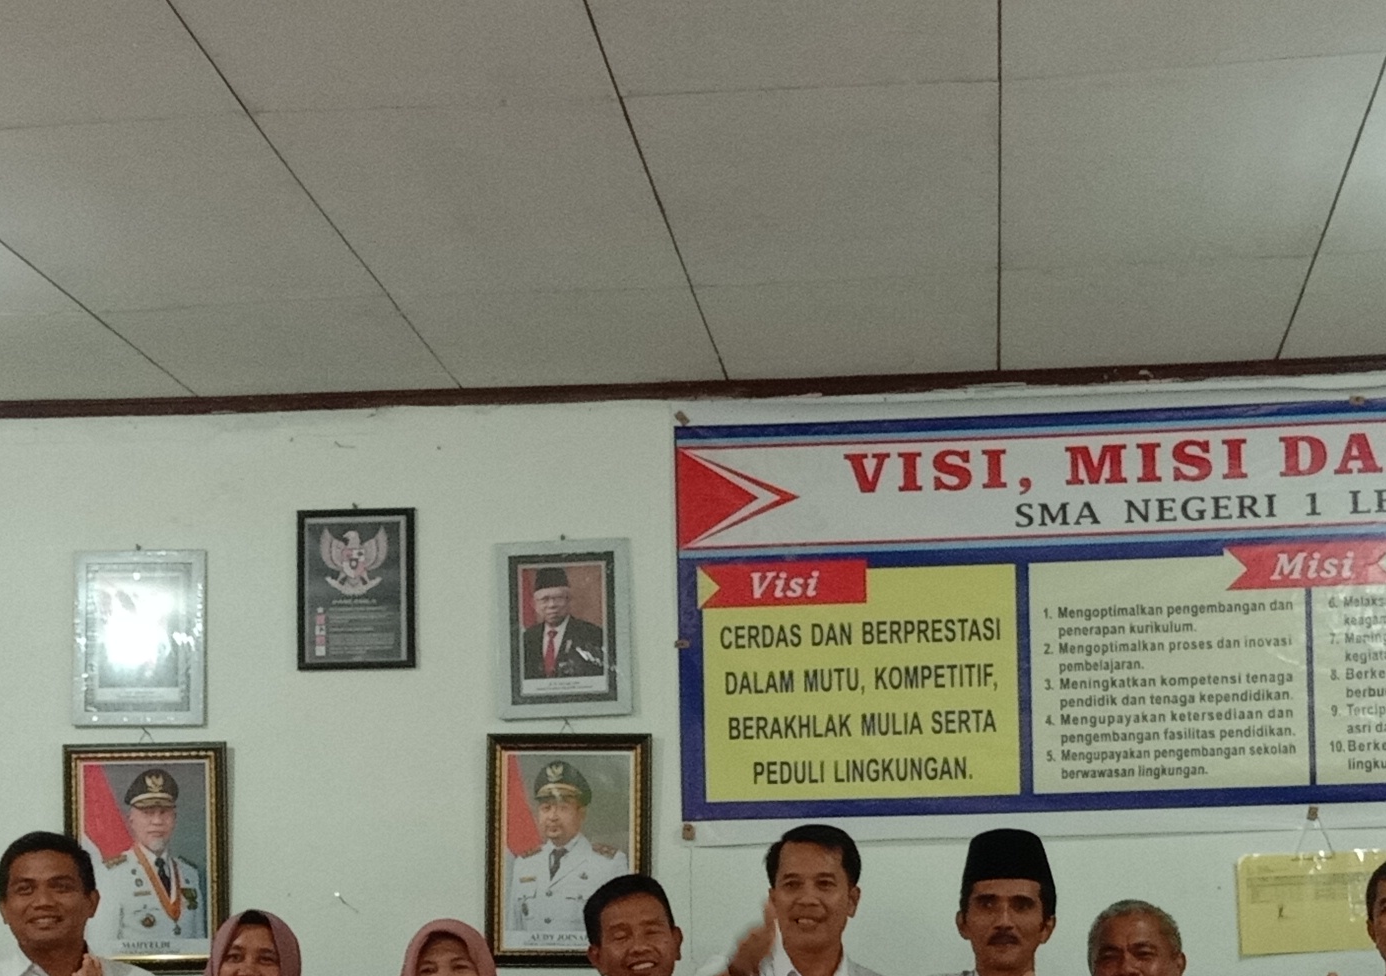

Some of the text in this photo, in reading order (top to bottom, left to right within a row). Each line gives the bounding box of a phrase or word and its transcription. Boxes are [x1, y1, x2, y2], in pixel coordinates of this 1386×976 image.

[843, 448, 1033, 496] VISI,
[1064, 437, 1248, 487] MISI
[1014, 501, 1102, 528] SMA
[1123, 493, 1278, 524] NEGERI
[1304, 492, 1322, 517] 1
[1271, 551, 1356, 580] Misi
[750, 570, 820, 600] Visi
[1057, 599, 1294, 621] Mengoptimalkan pengembangan dan
[719, 617, 1001, 650] CERDAS DAN BERPRESTASI
[1058, 620, 1198, 640] penerapan kurikulum.
[1043, 636, 1292, 657] 2. Mengoptimalkan proses dan inovasi
[1058, 659, 1146, 675] pembelajaran.
[724, 663, 1000, 697] DALAM MUTU, KOMPETITIF,
[1044, 672, 1294, 692] 3. Meningkatkan kompetensi tenaga
[1059, 688, 1294, 711] pendidik dan tenaga kependidikan.
[728, 708, 997, 741] BERAKHLAK MULIA SERTA
[1045, 707, 1294, 728] 4. Mengupayakan ketersediaan dan
[1347, 723, 1372, 734] asri
[1060, 724, 1296, 747] pengembangan fasilitas pendidikan.
[1046, 743, 1297, 764] 5. Mengupayakan pengembangan sekolah
[1329, 740, 1348, 754] 10.
[753, 756, 976, 785] PEDULI LINGKUNGAN.
[1061, 765, 1210, 780] berwawasan lingkungan.
